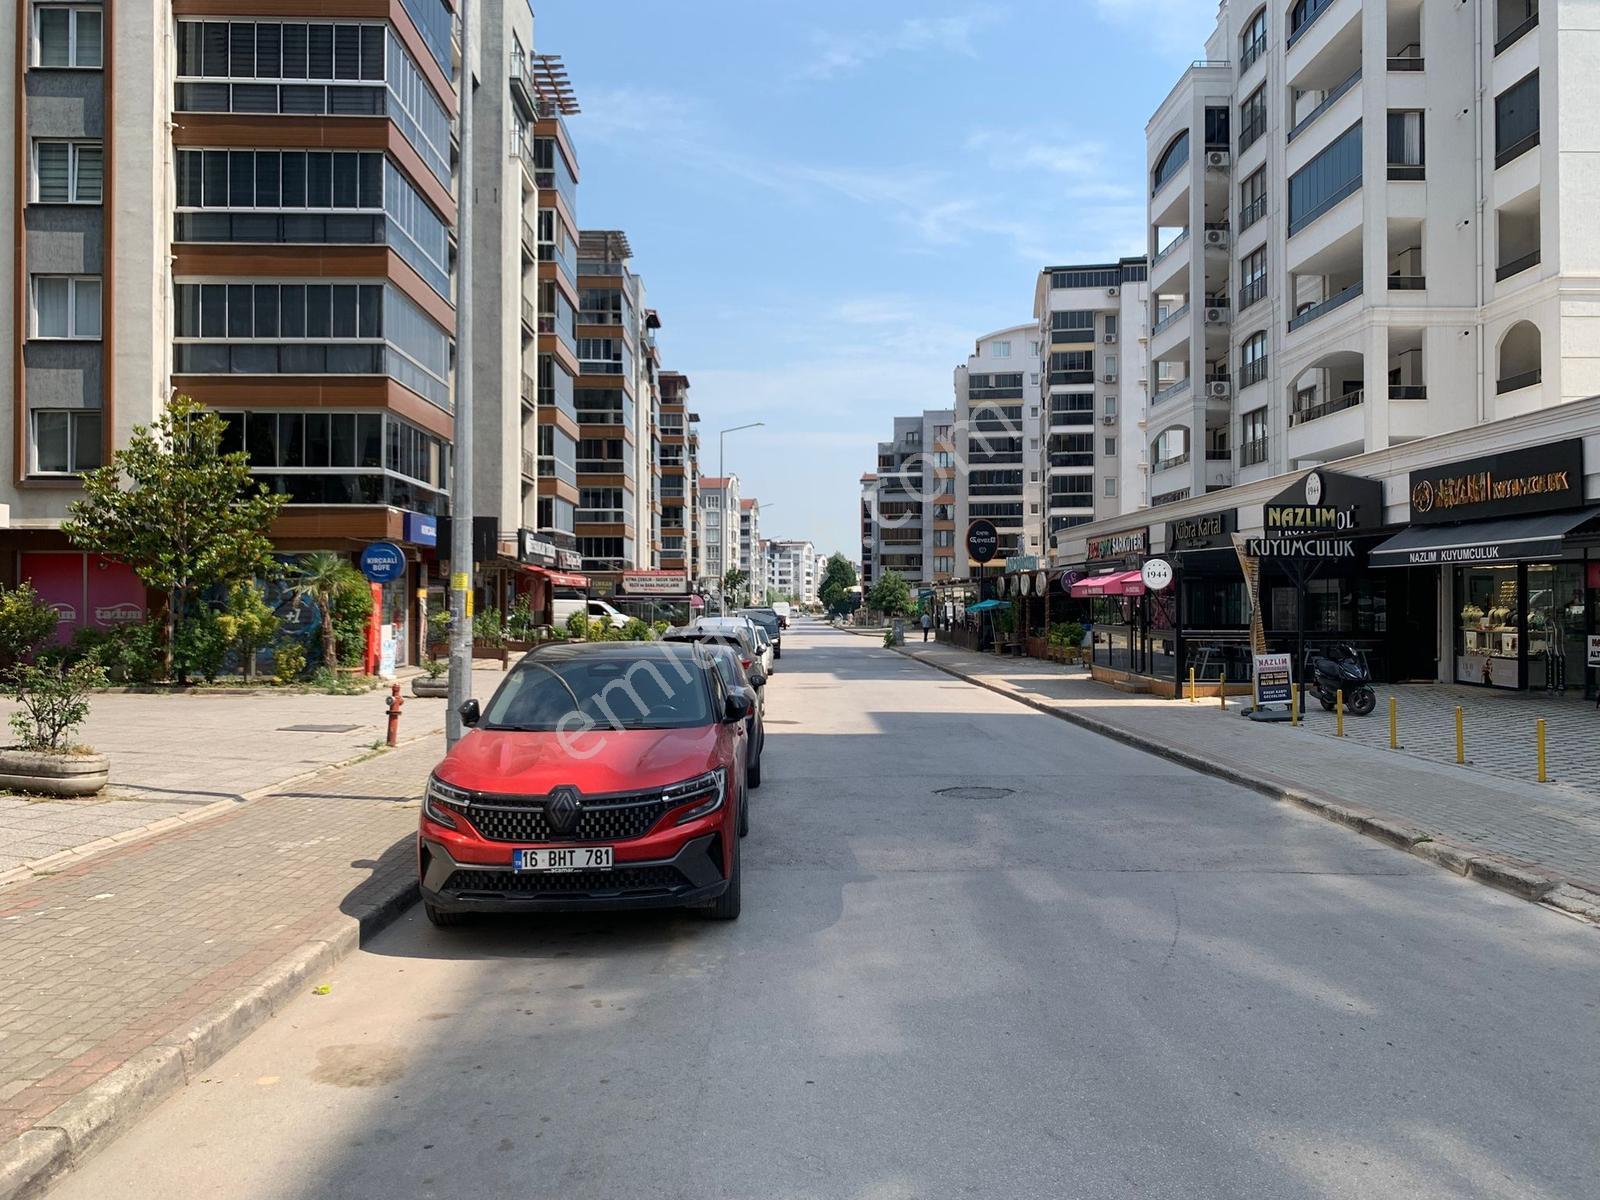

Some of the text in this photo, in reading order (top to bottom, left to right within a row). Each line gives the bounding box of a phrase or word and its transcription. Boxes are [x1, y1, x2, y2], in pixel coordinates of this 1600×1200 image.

[1268, 507, 1336, 527] NAZLIM
[1250, 540, 1355, 557] KUYUMCULUK
[1409, 546, 1499, 563] NAZLIM KUYUMCULUK
[367, 556, 397, 564] KIRCAALİ
[1147, 571, 1167, 579] 1944
[1258, 658, 1287, 666] NAZLIM
[523, 851, 538, 868] 16
[548, 850, 576, 867] BHT
[585, 849, 610, 866] 781
